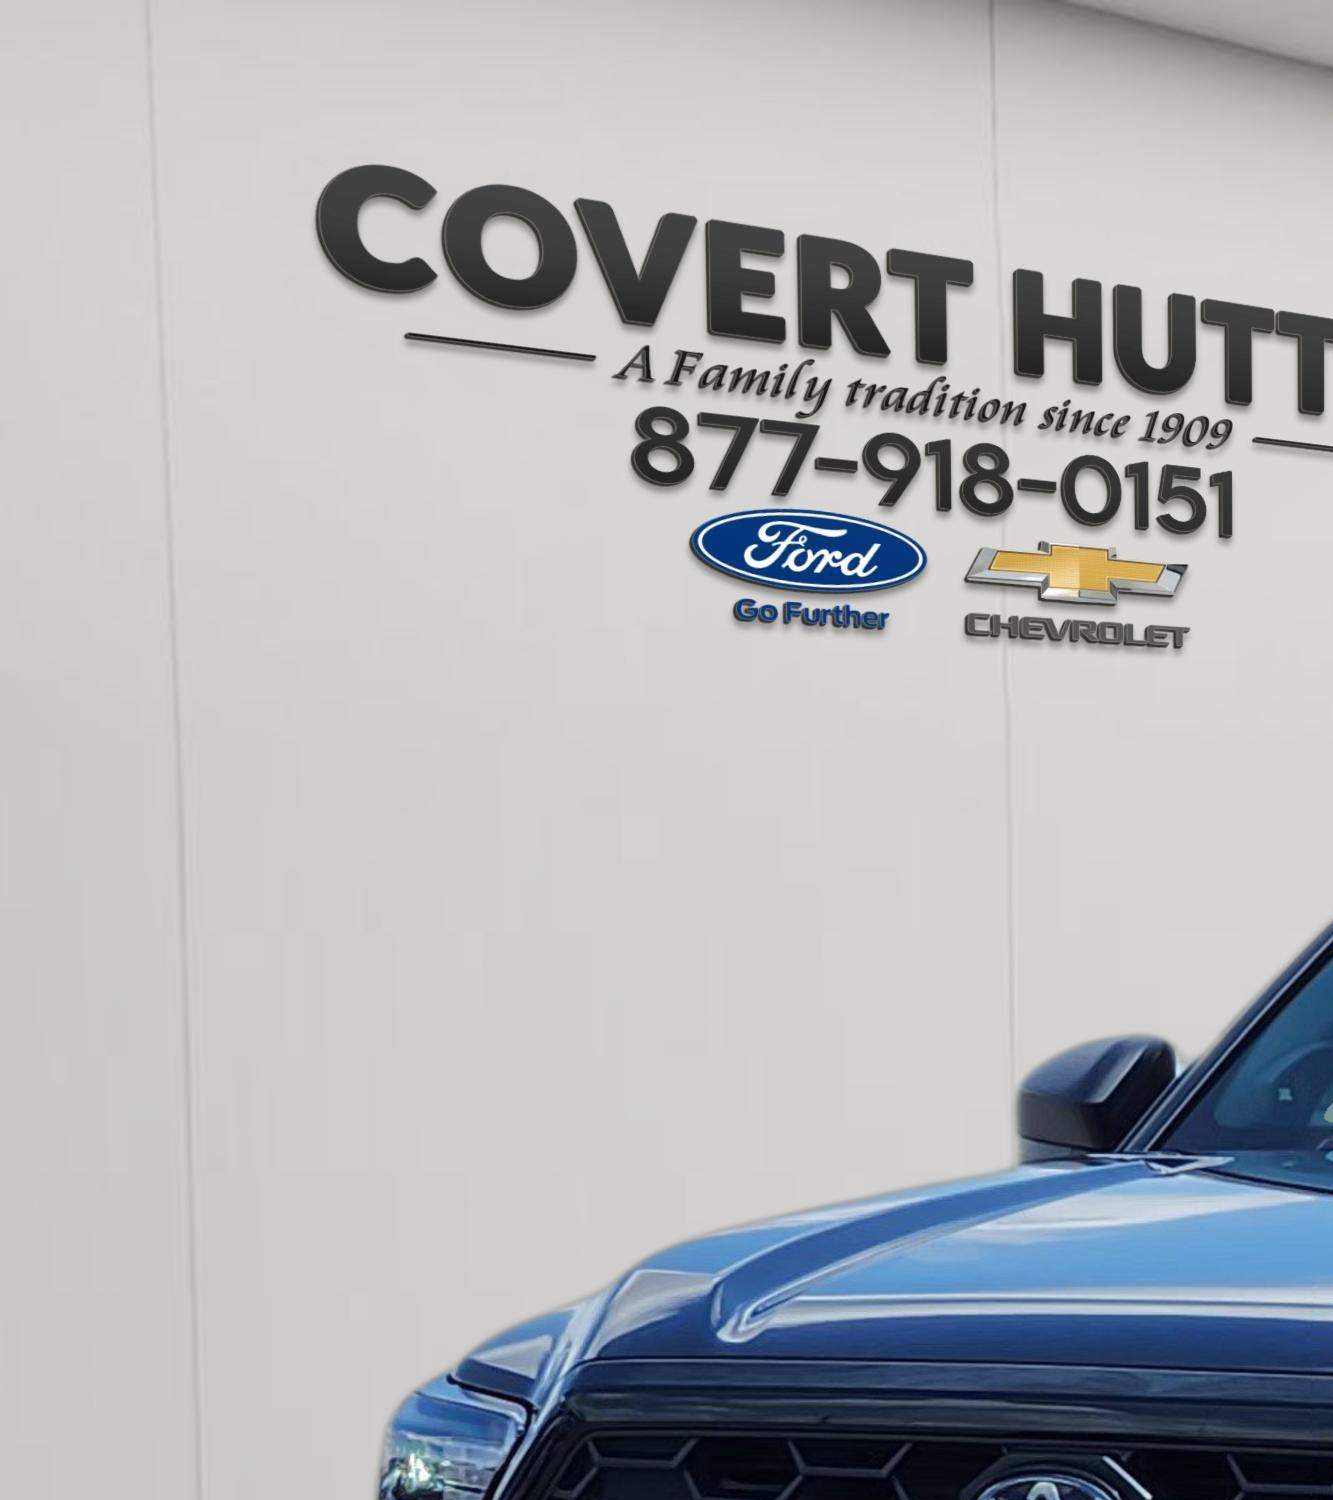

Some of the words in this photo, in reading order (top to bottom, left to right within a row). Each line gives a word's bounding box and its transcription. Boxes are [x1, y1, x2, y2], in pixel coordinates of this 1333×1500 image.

[316, 164, 975, 365] COVERT
[612, 345, 655, 383] A
[665, 350, 833, 418] Family
[845, 375, 1030, 427] tradition
[1037, 398, 1130, 439] since
[1137, 409, 1234, 451] 1909
[630, 405, 1234, 538] 877-918-0151
[743, 520, 881, 579] Ford
[734, 598, 779, 624] Go
[782, 601, 890, 630] Further
[964, 612, 1191, 650] CHEVROLET
